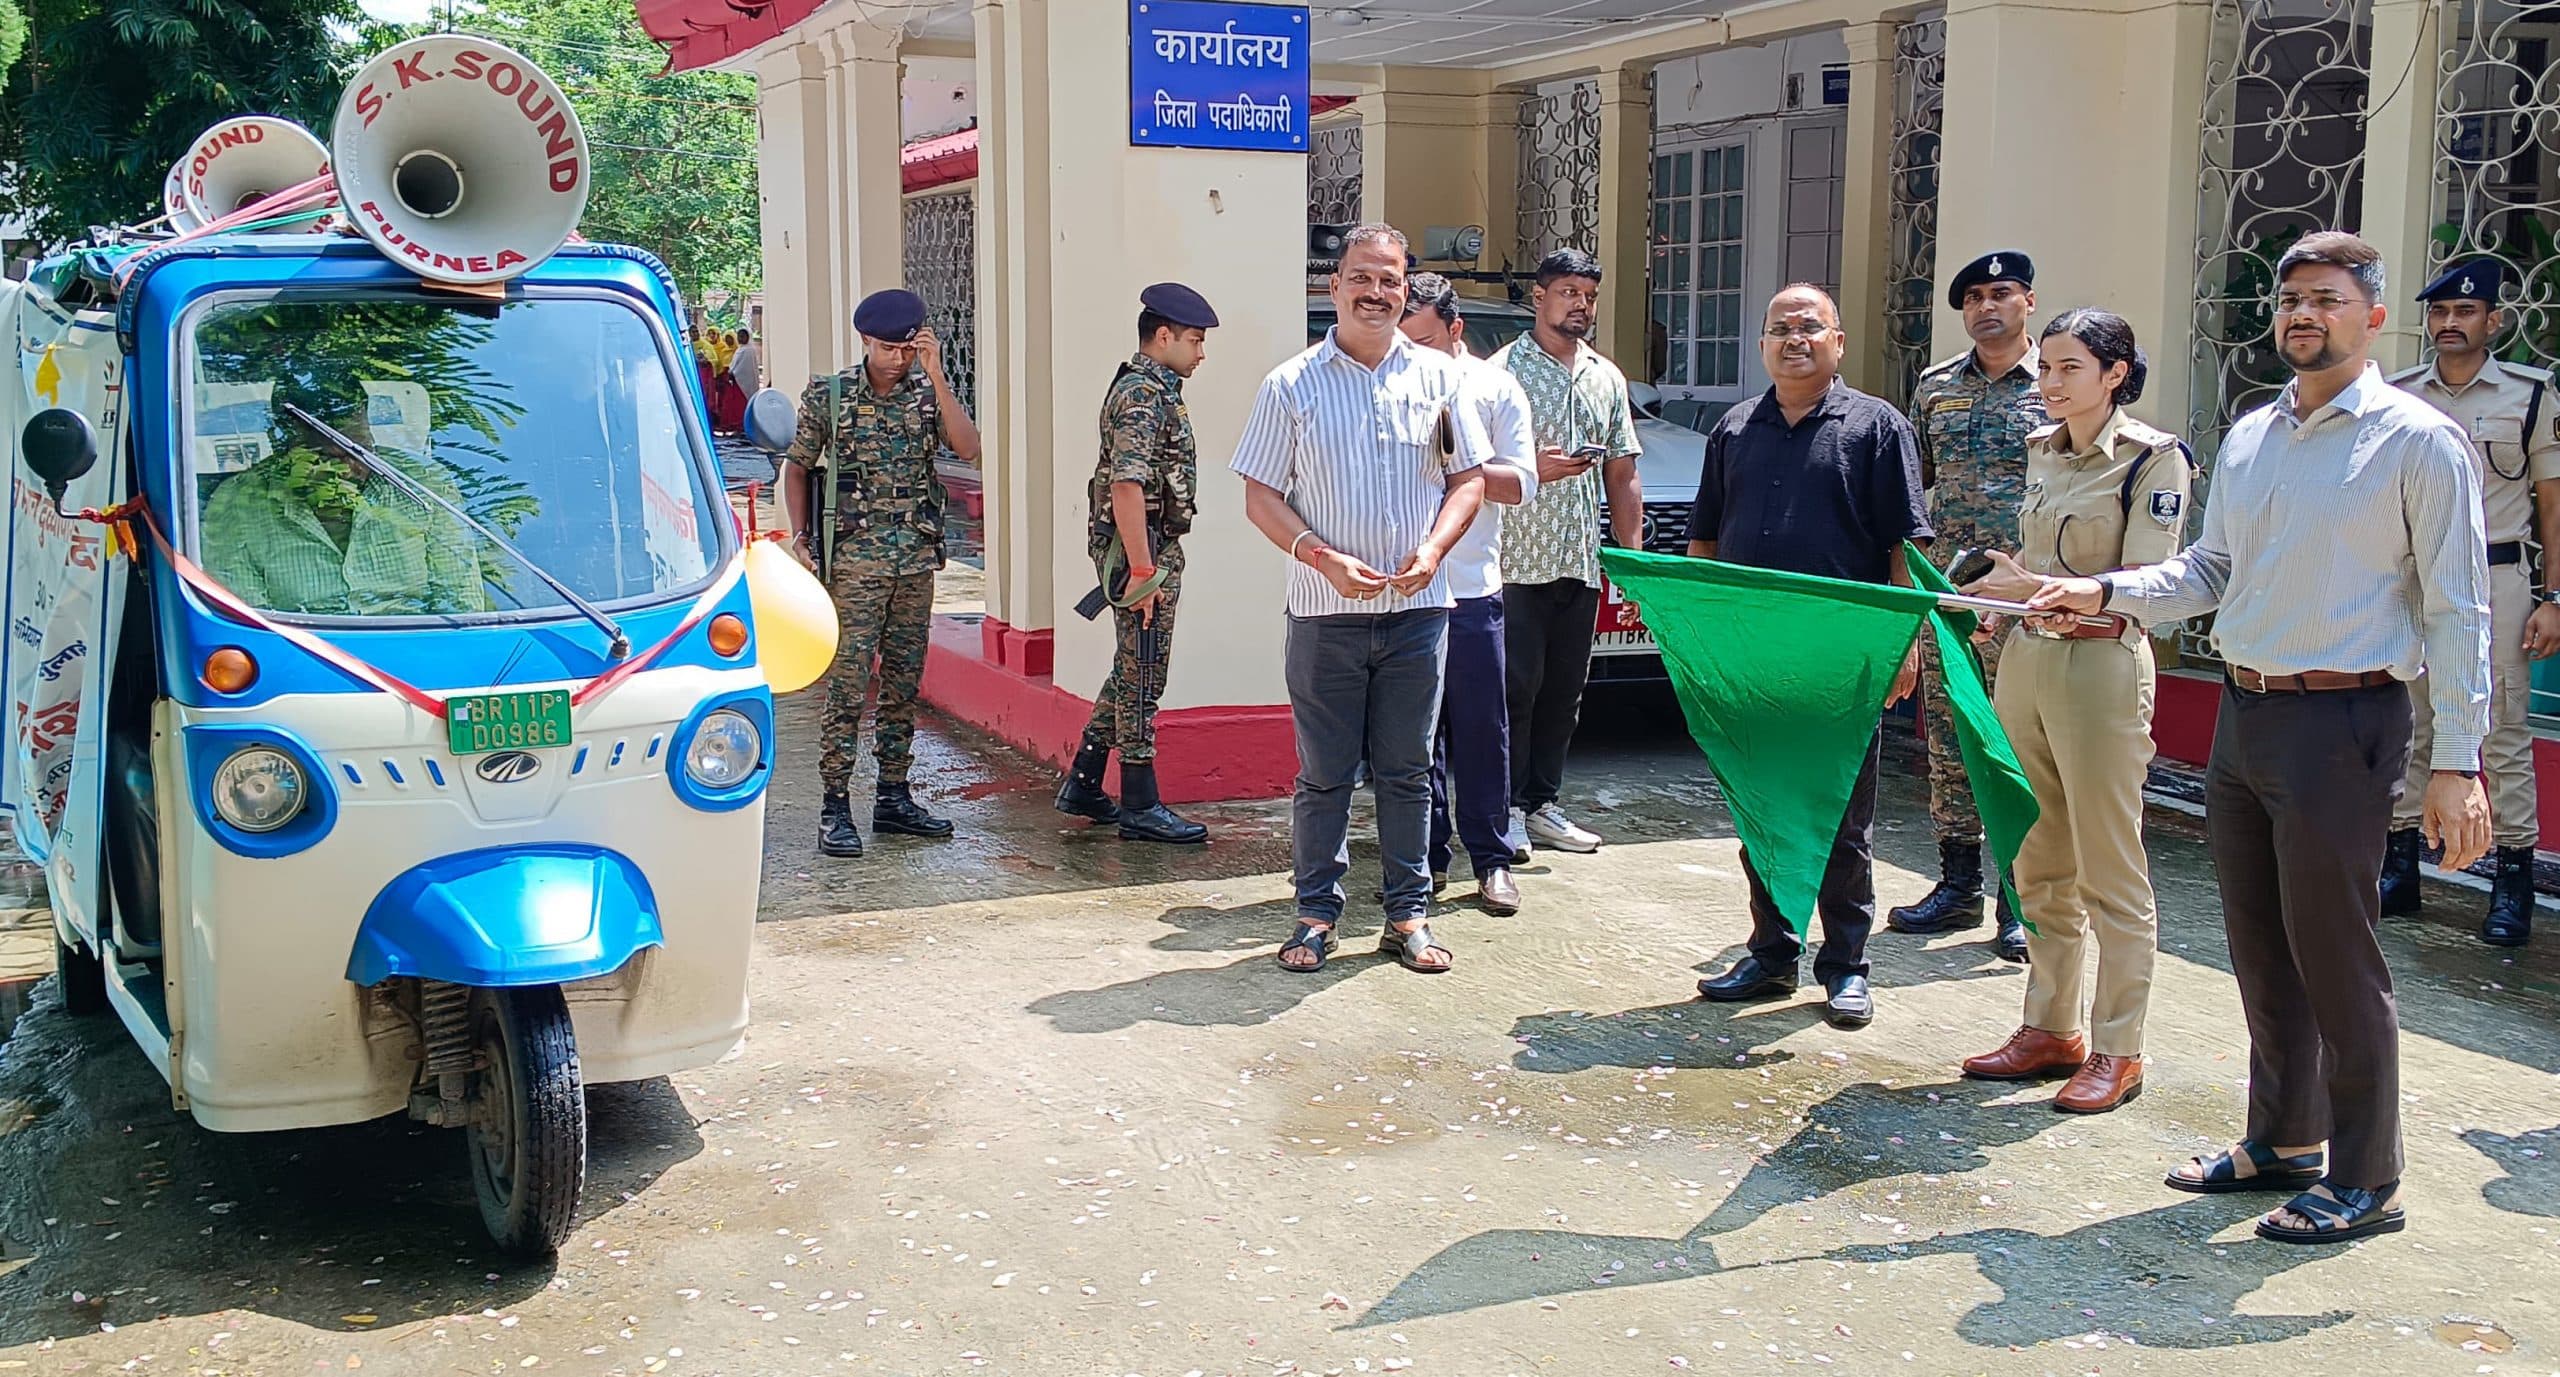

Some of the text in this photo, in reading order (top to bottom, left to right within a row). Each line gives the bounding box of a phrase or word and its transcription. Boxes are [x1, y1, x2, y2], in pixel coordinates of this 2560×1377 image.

[1152, 20, 1291, 68] कार्यालय
[1154, 89, 1291, 133] जिला पदाधिकारी
[360, 201, 528, 273] PURNEA
[471, 693, 555, 723] BR11P
[474, 719, 558, 750] D0986
